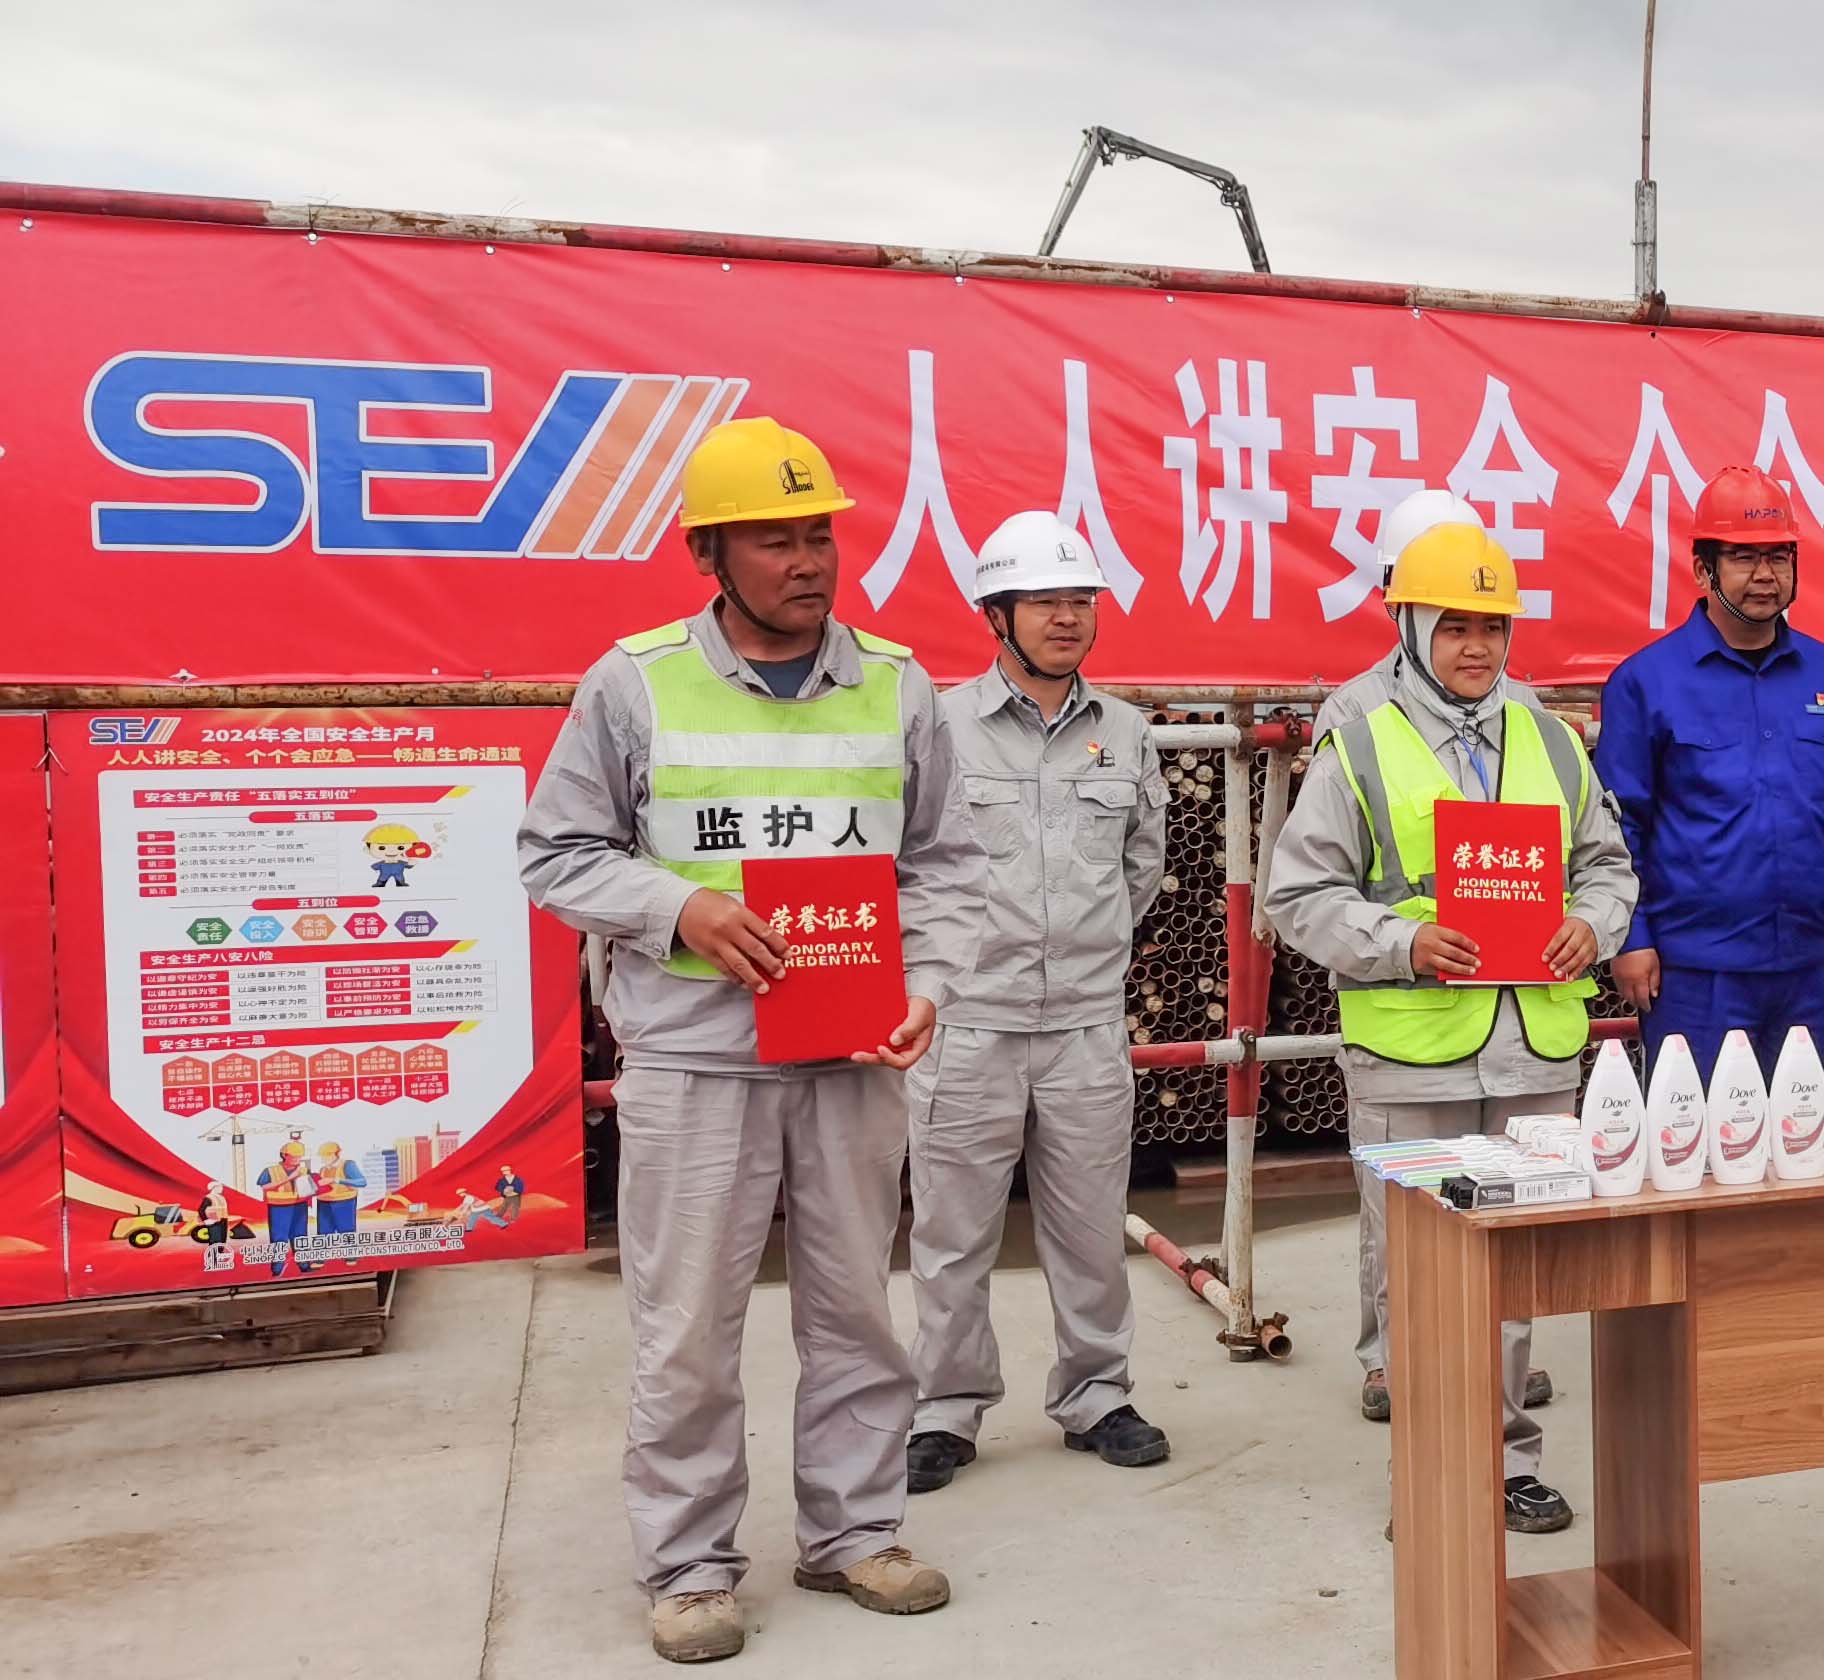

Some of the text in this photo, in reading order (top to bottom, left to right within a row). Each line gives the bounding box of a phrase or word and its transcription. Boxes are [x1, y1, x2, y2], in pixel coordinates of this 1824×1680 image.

[201, 727, 435, 743] 2024年全国安全生产月
[293, 811, 336, 822] 五落实
[693, 803, 869, 853] 监护人
[1452, 841, 1546, 873] 荣誉证书
[1458, 877, 1540, 890] HONORARY
[1453, 887, 1547, 902] CREDENTIAL
[354, 917, 379, 926] 安全
[768, 901, 878, 936] 荣誉证书
[196, 923, 223, 932] 安全
[789, 941, 874, 956] ONORARY
[151, 951, 274, 967] 安全生产八安八险
[784, 953, 881, 968] REDENTIAL
[159, 1034, 266, 1050] 安全生产十二忌
[1728, 1087, 1757, 1099] Dove
[1790, 1082, 1819, 1094] Dove
[1601, 1097, 1631, 1109] Dove
[1670, 1092, 1696, 1104] Dove
[294, 1225, 465, 1250] 中石化第四建设有限公司
[294, 1250, 330, 1261] SINOPEC
